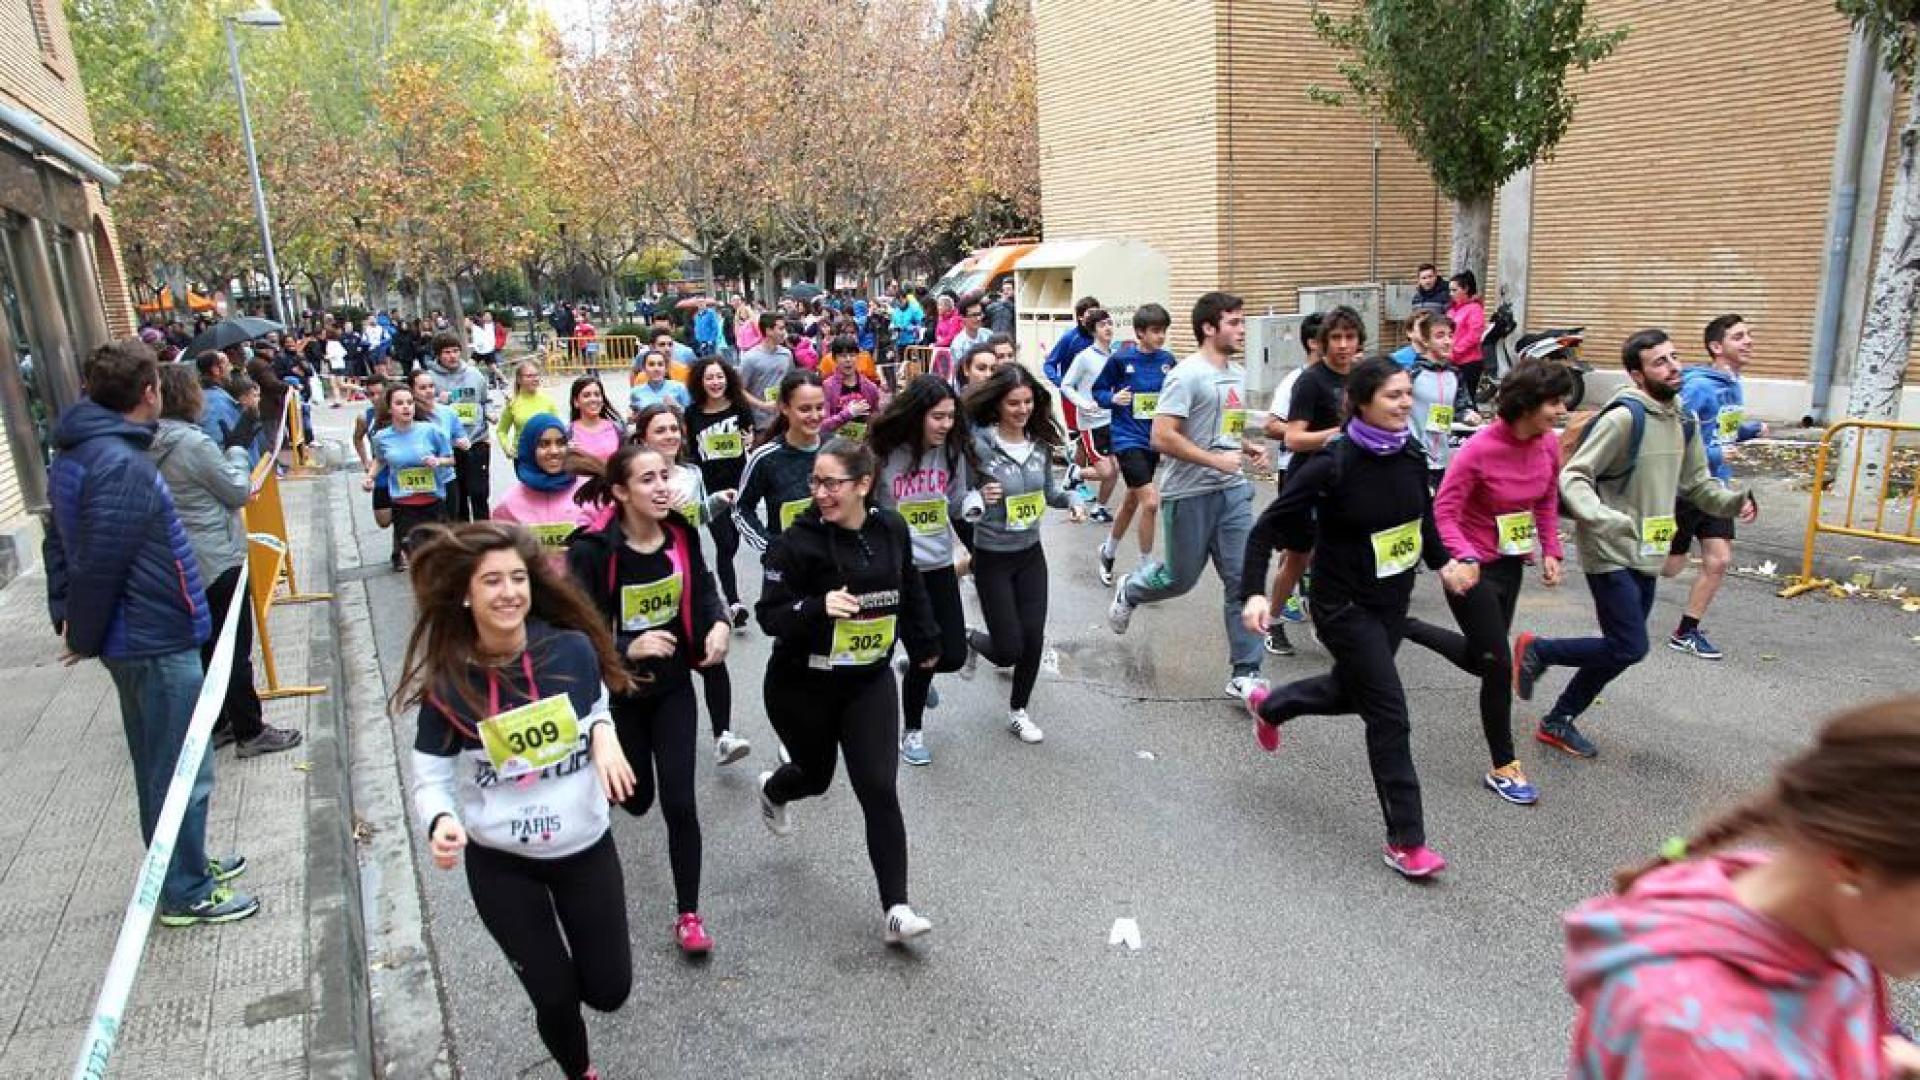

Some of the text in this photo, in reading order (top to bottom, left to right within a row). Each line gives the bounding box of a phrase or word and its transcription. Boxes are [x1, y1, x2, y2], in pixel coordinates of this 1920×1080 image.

[910, 510, 938, 524] 306
[1016, 503, 1037, 519] 301
[1390, 536, 1414, 557] 406
[639, 593, 672, 615] 304
[848, 633, 883, 652] 302
[508, 720, 559, 754] 309
[511, 813, 561, 836] PARIS
